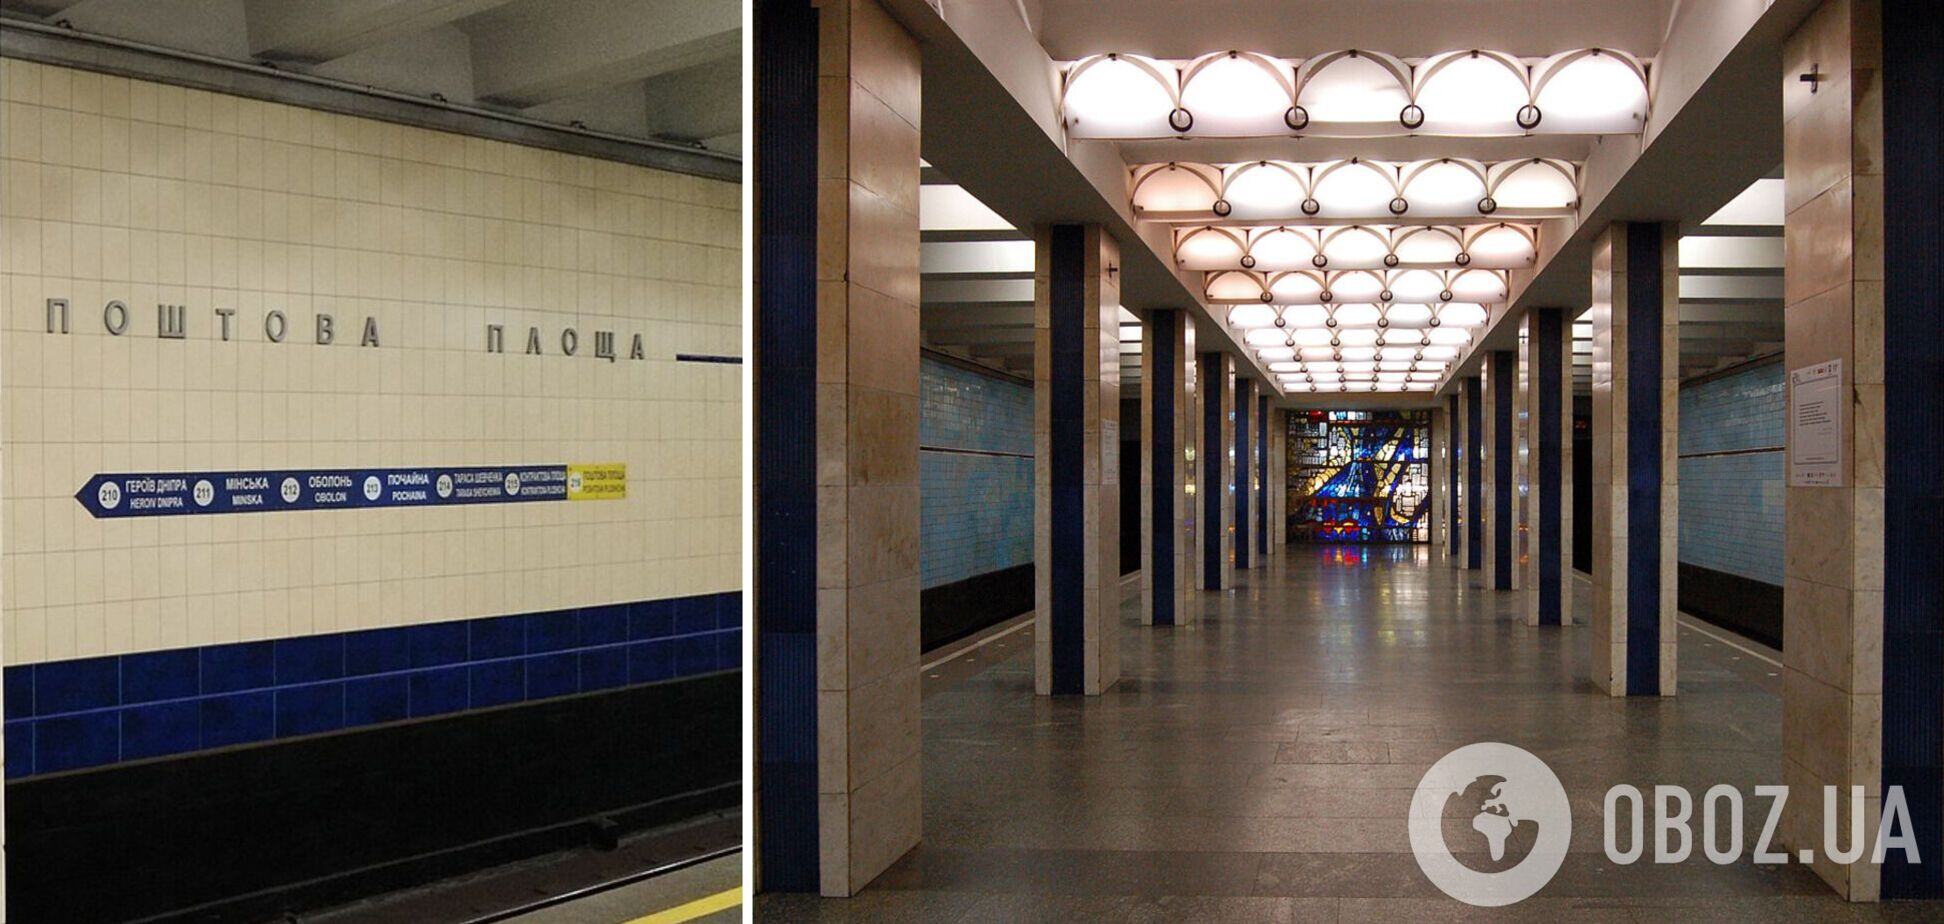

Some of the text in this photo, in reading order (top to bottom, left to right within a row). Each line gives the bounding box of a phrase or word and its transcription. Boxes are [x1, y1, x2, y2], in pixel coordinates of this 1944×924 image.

[46, 298, 645, 363] ПОШТОВА ПЛОЩА
[225, 478, 269, 490] МІНСЬКА
[308, 476, 353, 488] ОБОЛОНЬ
[387, 472, 430, 486] ПОЧАЙНА
[125, 477, 187, 494] ГЕРОЇВ ДНІПРА
[283, 484, 297, 495] 212
[366, 483, 379, 494] 213
[102, 488, 118, 501] 210
[196, 488, 211, 499] 211
[232, 494, 263, 505] MINSKA
[314, 492, 347, 503] OBOLON
[130, 497, 183, 509] HEROIV DNIPRA
